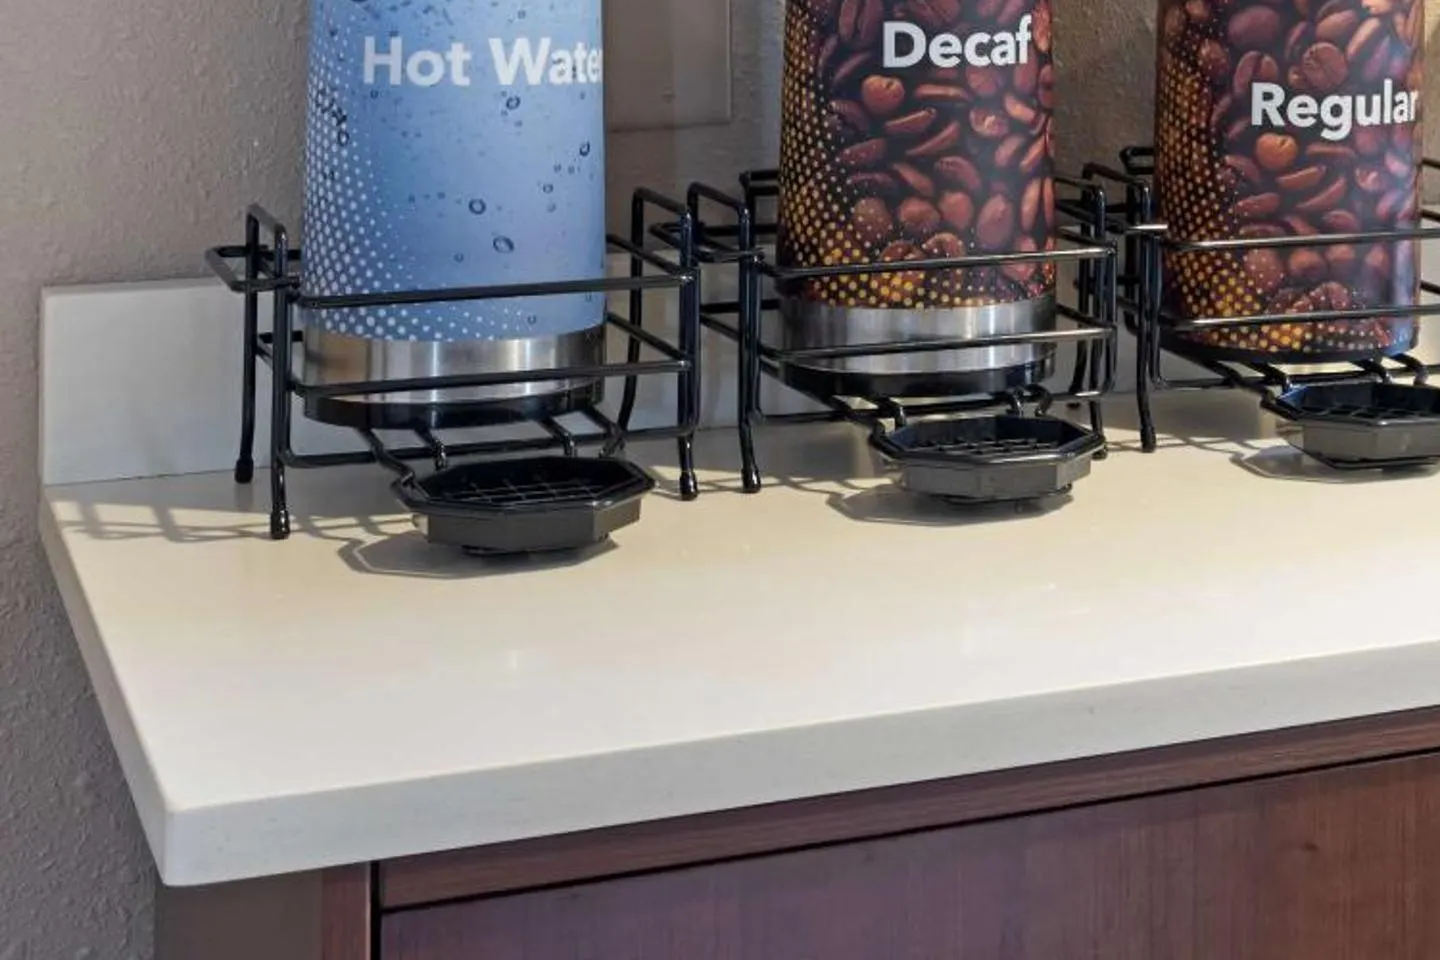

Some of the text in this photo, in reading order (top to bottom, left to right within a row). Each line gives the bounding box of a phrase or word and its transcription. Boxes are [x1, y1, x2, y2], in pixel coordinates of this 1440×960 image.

[363, 36, 603, 86] Hot Wate
[882, 14, 1032, 68] Decaf
[1251, 78, 1418, 141] Regular
